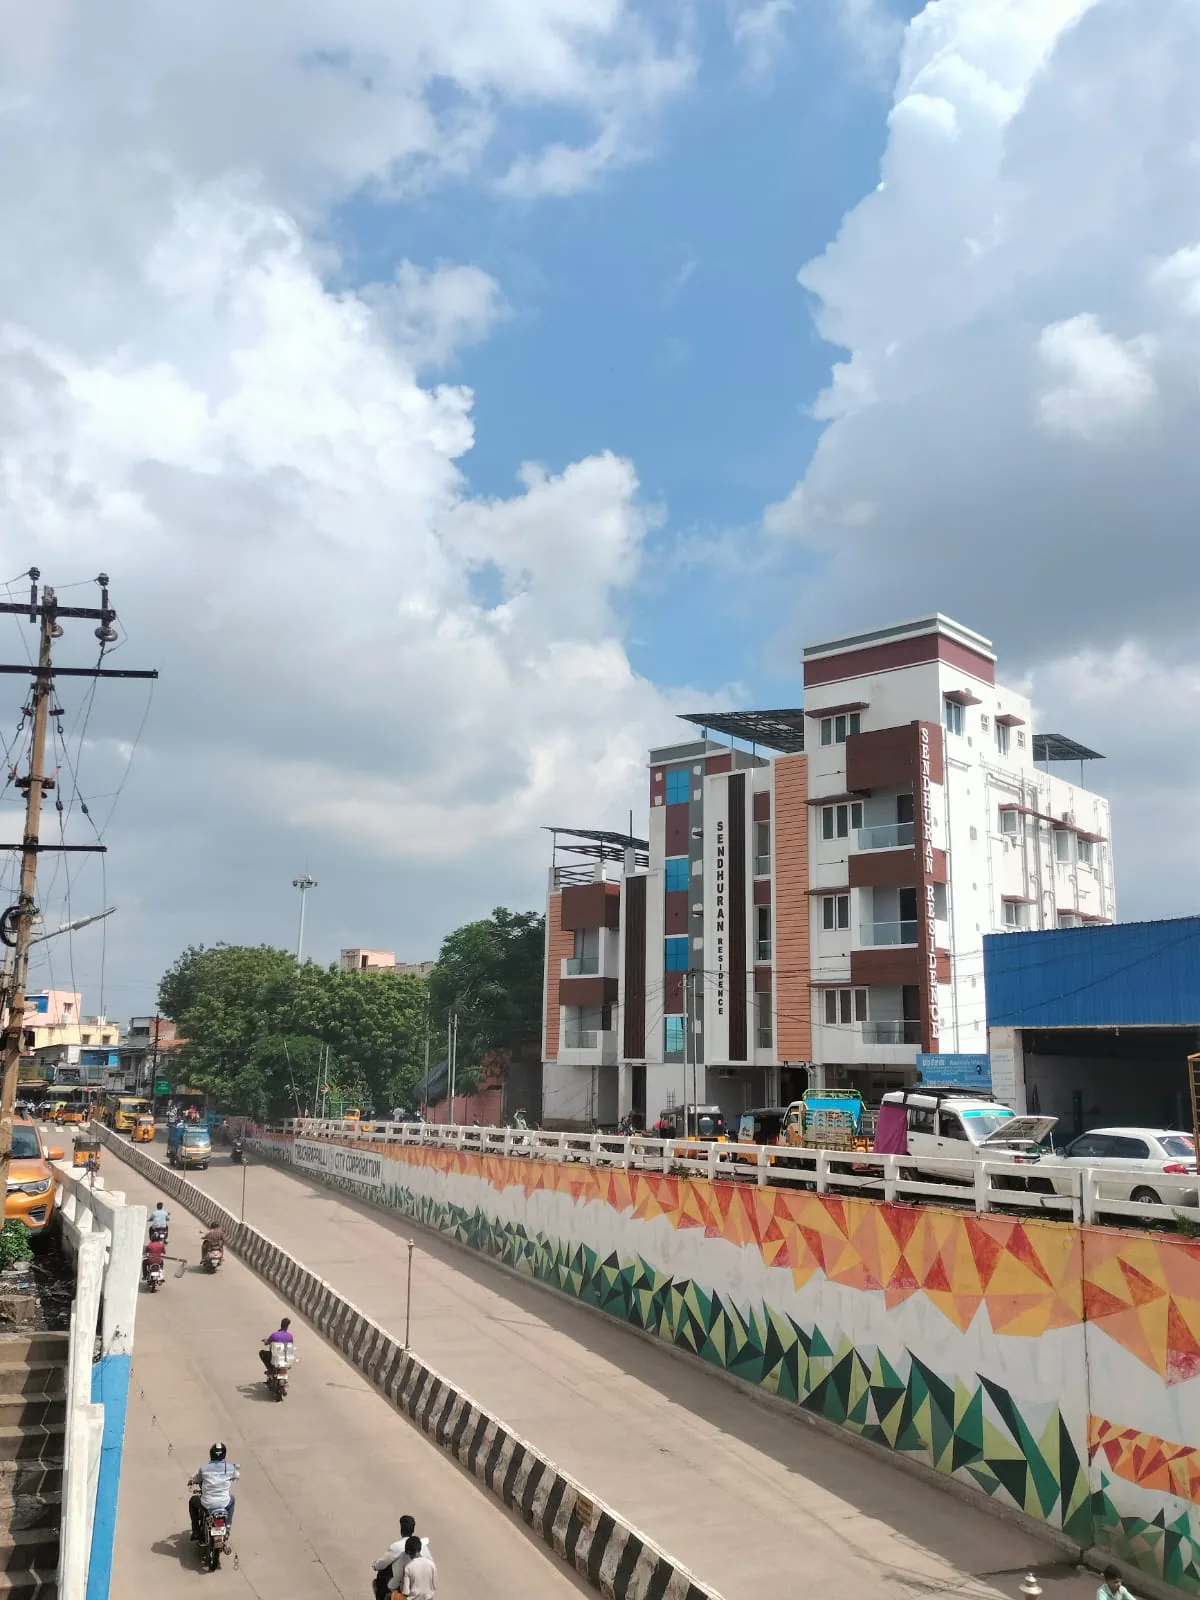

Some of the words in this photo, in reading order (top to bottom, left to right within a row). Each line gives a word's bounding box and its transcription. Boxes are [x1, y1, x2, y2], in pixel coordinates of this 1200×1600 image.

[920, 727, 933, 873] SENDHURAN
[716, 821, 725, 932] SENDHURAN
[926, 884, 939, 1039] RESIDENCE
[334, 1152, 346, 1170] CITY
[345, 1154, 381, 1180] CORPORATION
